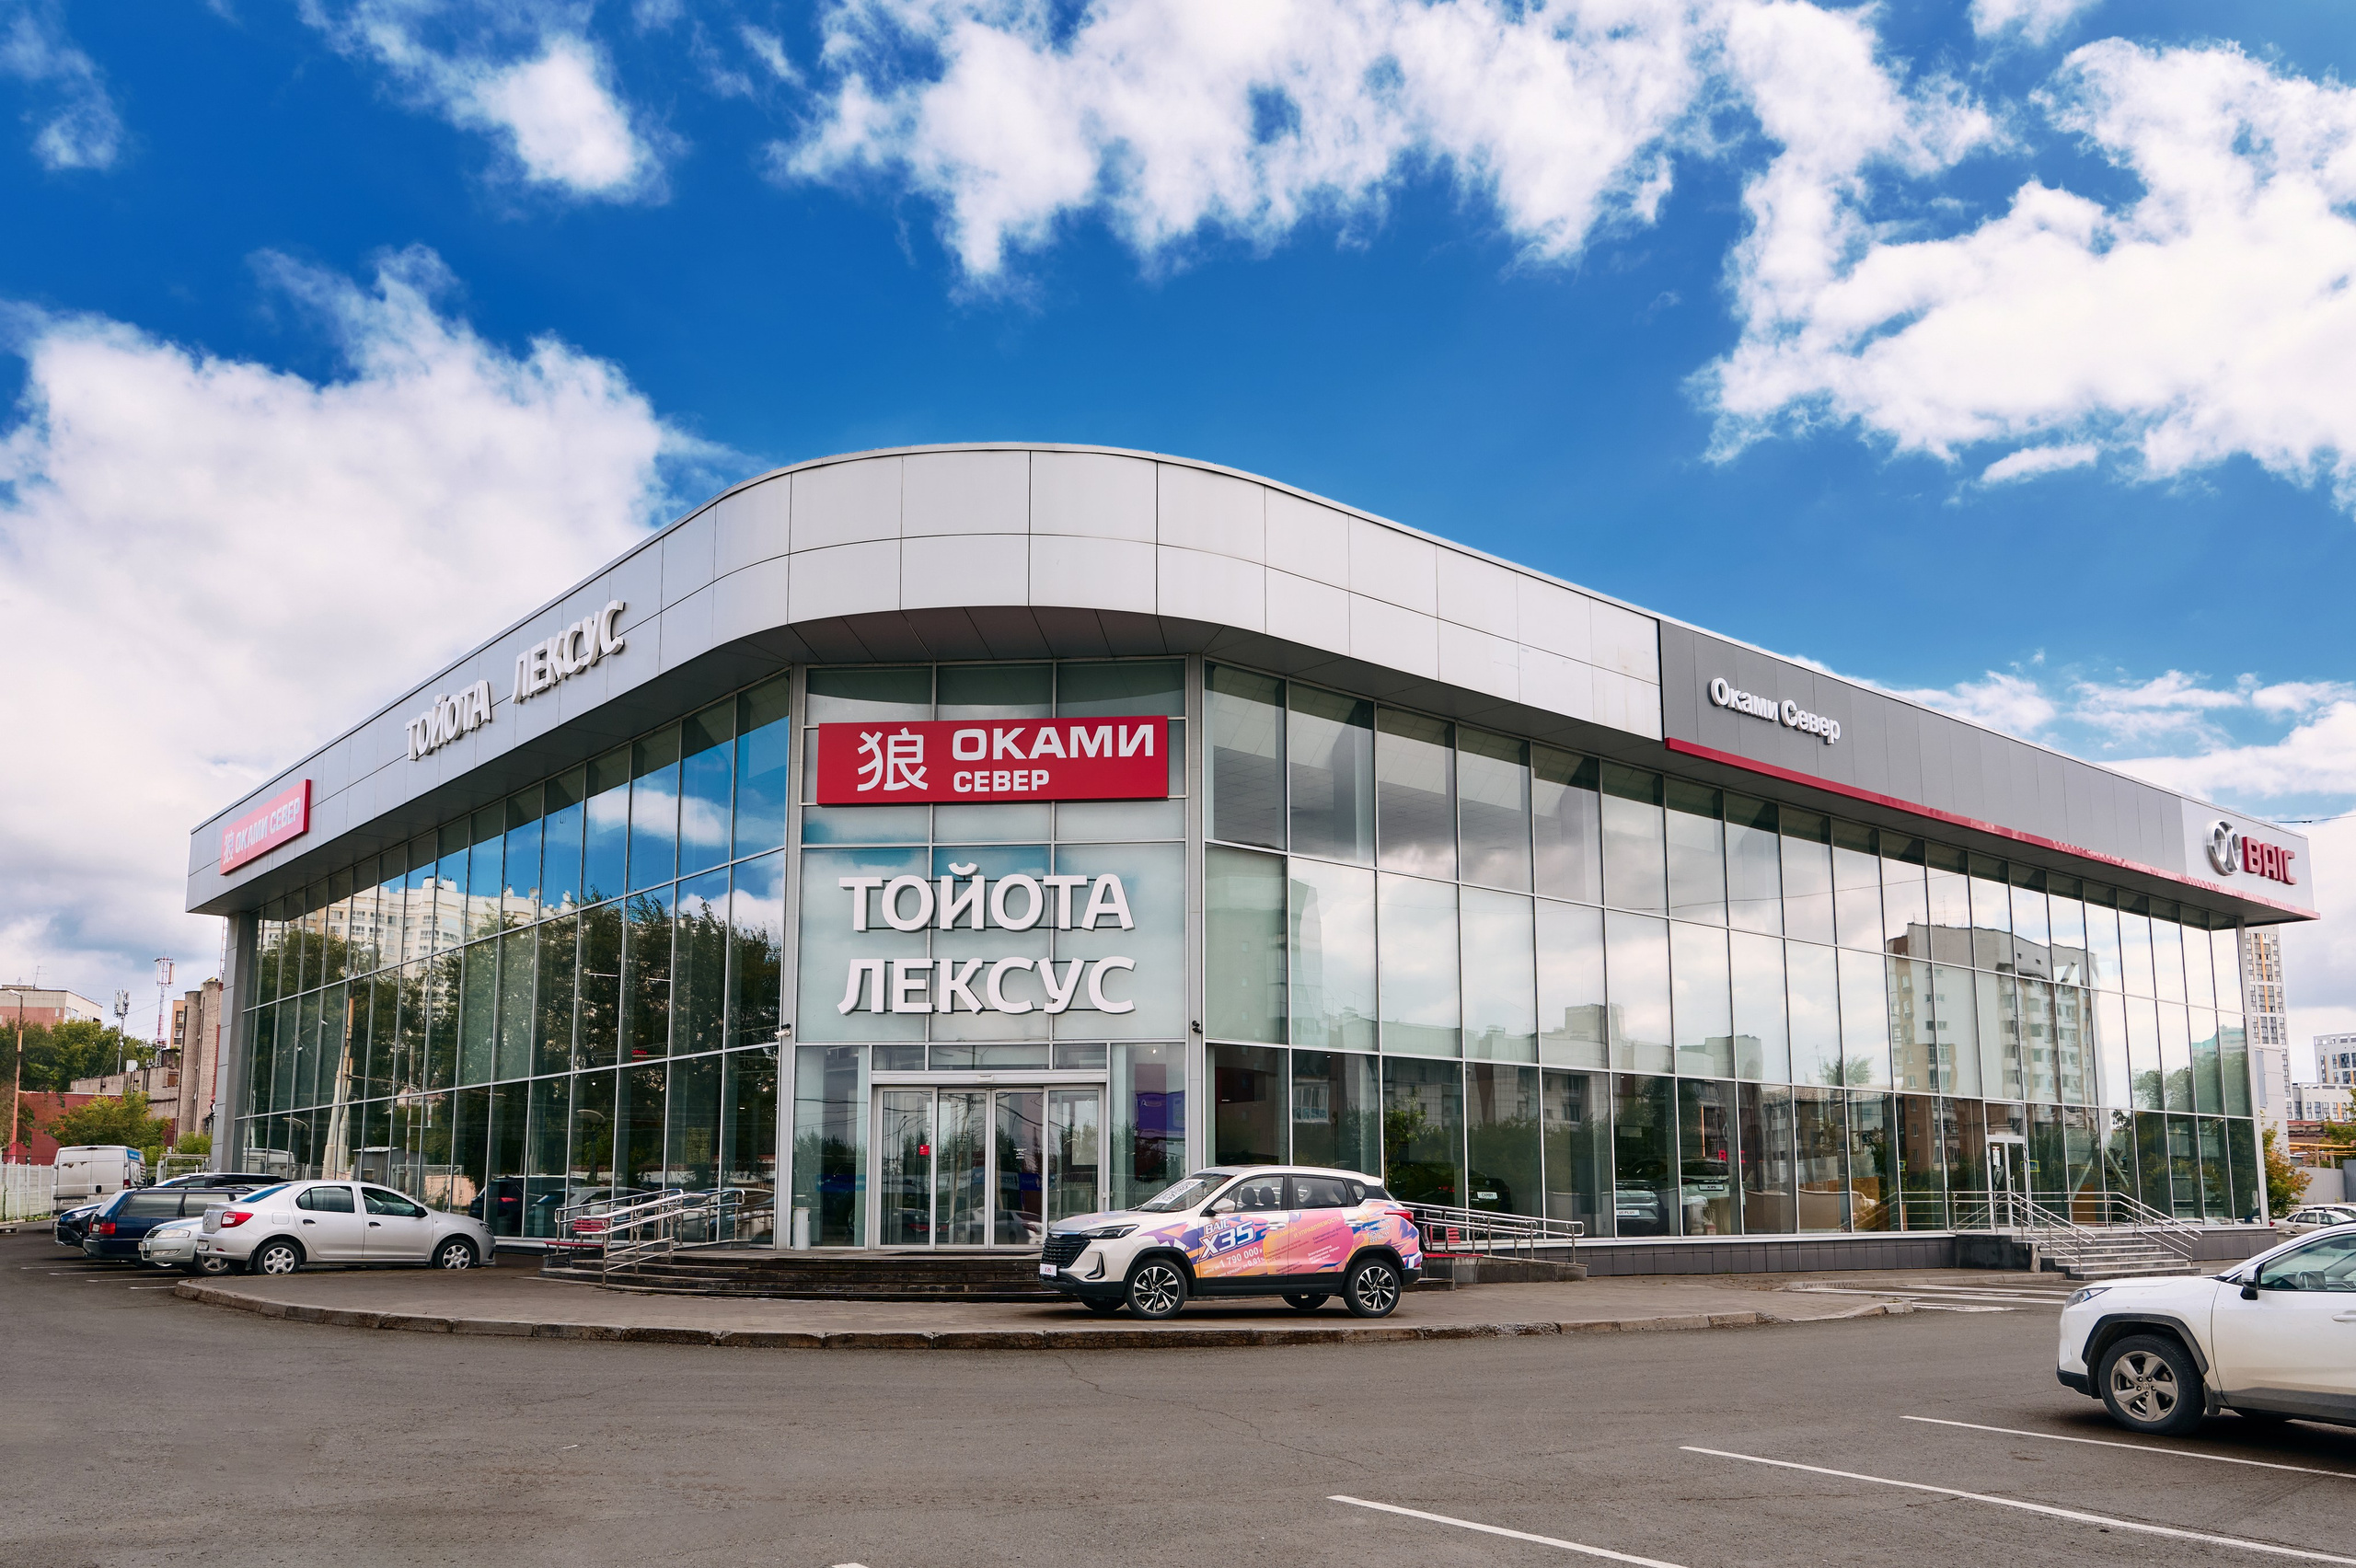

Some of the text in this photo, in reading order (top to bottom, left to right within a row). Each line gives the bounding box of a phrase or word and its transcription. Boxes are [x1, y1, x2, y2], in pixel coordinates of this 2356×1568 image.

[405, 599, 624, 761] ТОЙОТА ЛЕКСУС
[1709, 676, 1842, 744] Оками Север
[857, 727, 929, 791] 狼
[952, 723, 1155, 761] ОКАМИ
[953, 769, 1050, 792] СЕВЕР
[235, 815, 269, 854] ОКАМИ
[270, 797, 301, 835] СЕВЕР
[2242, 836, 2298, 885] BAIC
[838, 862, 1136, 931] ТОЙОТА
[837, 956, 1137, 1015] ЛЕКСУС
[1199, 1220, 1254, 1259] X35
[1206, 1218, 1230, 1235] BAIC
[1227, 1254, 1242, 1265] 790
[1244, 1247, 1259, 1259] 000
